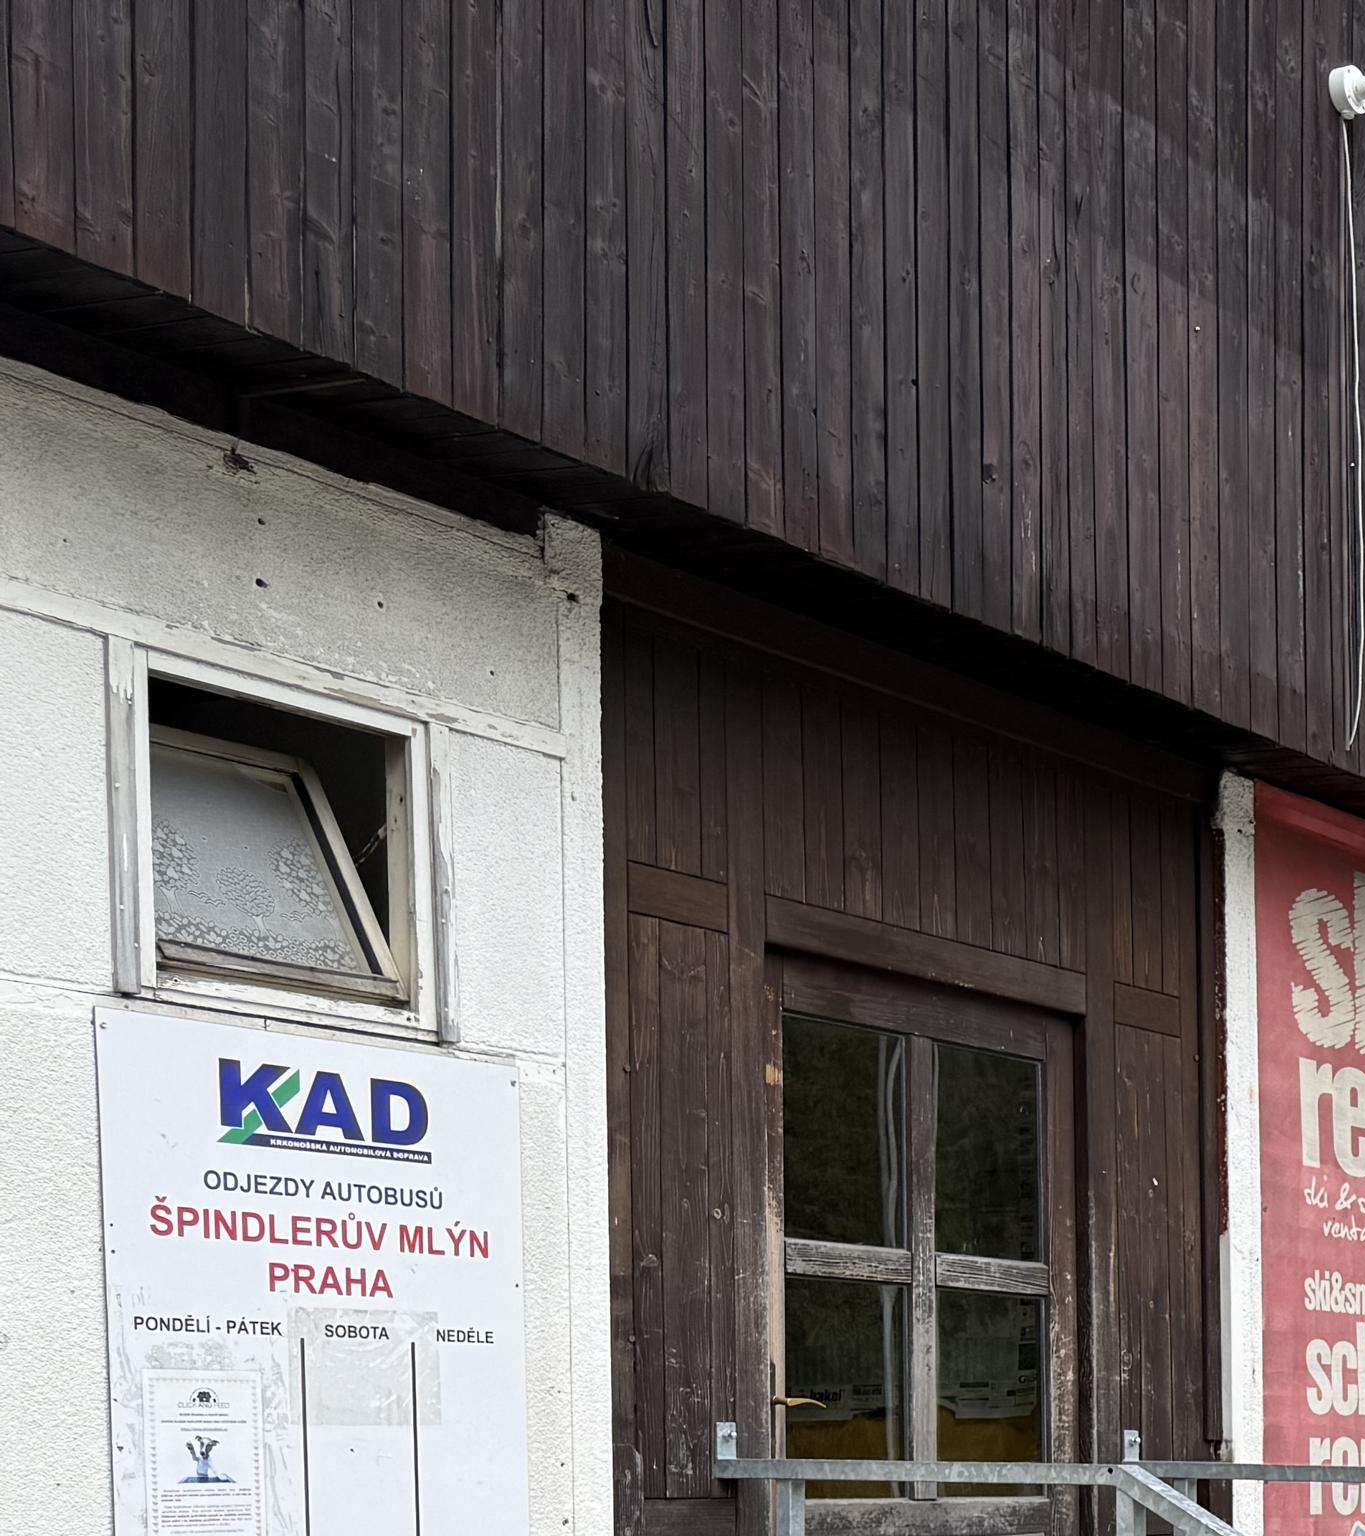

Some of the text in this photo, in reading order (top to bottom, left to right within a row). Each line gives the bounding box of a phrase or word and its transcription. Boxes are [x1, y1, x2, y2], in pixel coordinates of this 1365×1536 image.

[217, 1057, 429, 1146] KAD
[203, 1170, 444, 1210] ODJEZDY AUTOBUSŮ
[1303, 1175, 1329, 1209] ski
[1334, 1182, 1357, 1211] &
[149, 1195, 490, 1259] ŠPINDLERŮV MLÝN
[268, 1262, 394, 1299] PRAHA
[132, 1315, 211, 1334] PONDĚLÍ
[225, 1317, 283, 1336] PÁTEK
[323, 1324, 390, 1341] SOBOTA
[435, 1327, 495, 1344] NEDĚLE
